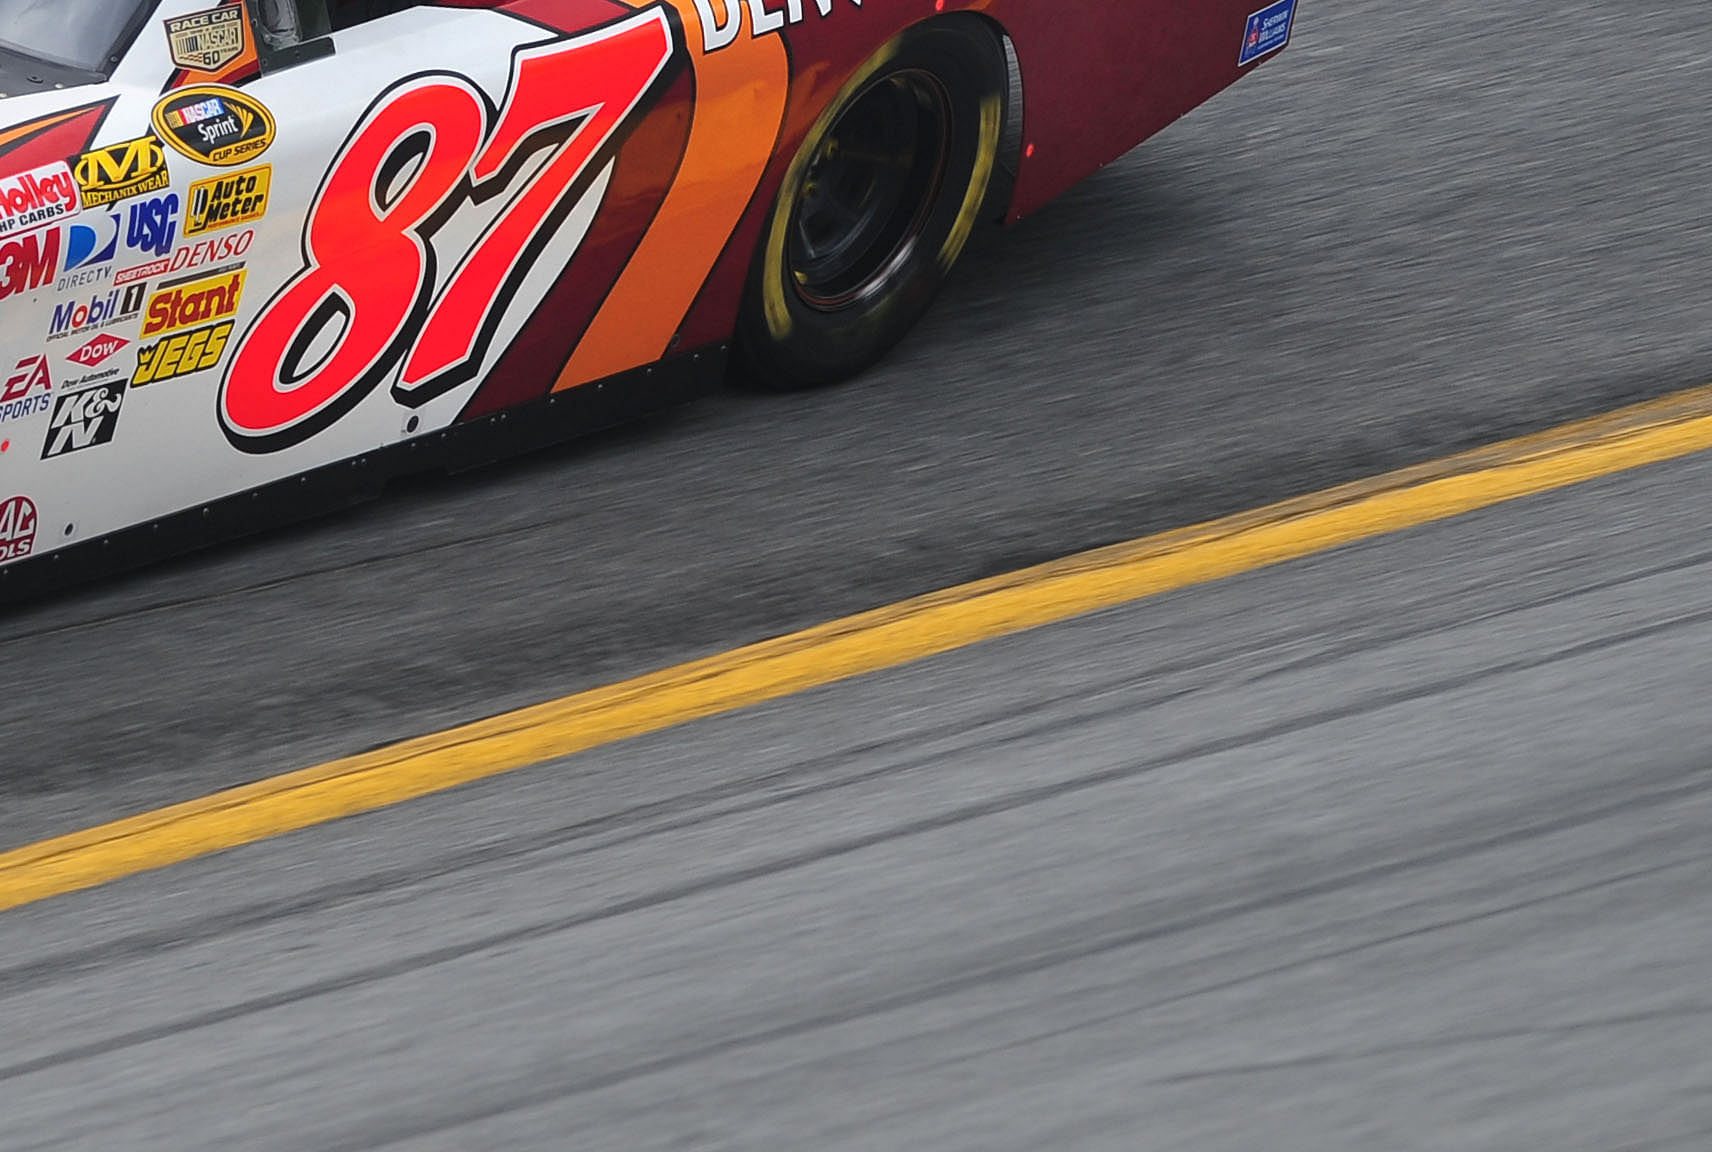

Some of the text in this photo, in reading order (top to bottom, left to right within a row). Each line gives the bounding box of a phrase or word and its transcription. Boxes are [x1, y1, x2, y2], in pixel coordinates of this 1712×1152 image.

[170, 15, 209, 33] RACE
[211, 9, 239, 23] CAR
[198, 26, 240, 52] NASCAR
[202, 50, 220, 66] 60
[183, 98, 223, 124] NASCAR
[197, 114, 238, 144] Sprint
[211, 137, 267, 162] CUP SERIES
[81, 171, 170, 208] MECHANIX WEAR
[211, 175, 257, 201] Auto
[19, 203, 64, 226] CARBS
[205, 194, 265, 223] Meter
[126, 192, 180, 257] USG
[218, 0, 693, 454] 87
[169, 229, 254, 273] DENSO
[56, 265, 113, 292] DIRECTV
[49, 289, 120, 335] Mobil
[144, 274, 241, 335] Stant
[133, 320, 234, 388] JEGS
[0, 353, 52, 404] EA
[60, 376, 79, 390] Dow
[79, 367, 120, 384] Automotive
